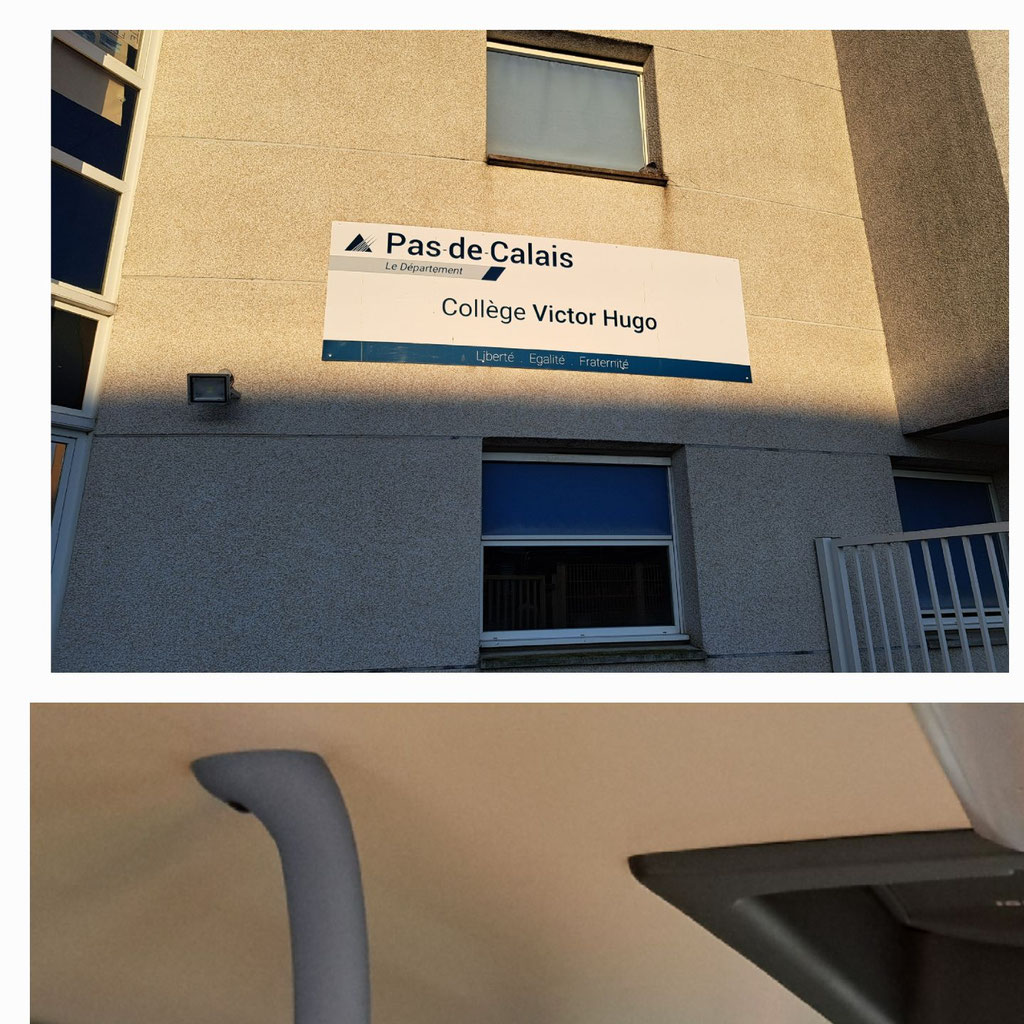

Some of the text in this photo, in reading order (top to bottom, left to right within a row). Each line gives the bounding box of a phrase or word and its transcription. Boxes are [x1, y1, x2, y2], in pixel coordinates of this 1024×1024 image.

[385, 262, 464, 275] Le Département
[442, 297, 658, 334] Collège Victor Hugo
[476, 350, 515, 363] Liberté
[579, 356, 630, 370] Fraternité
